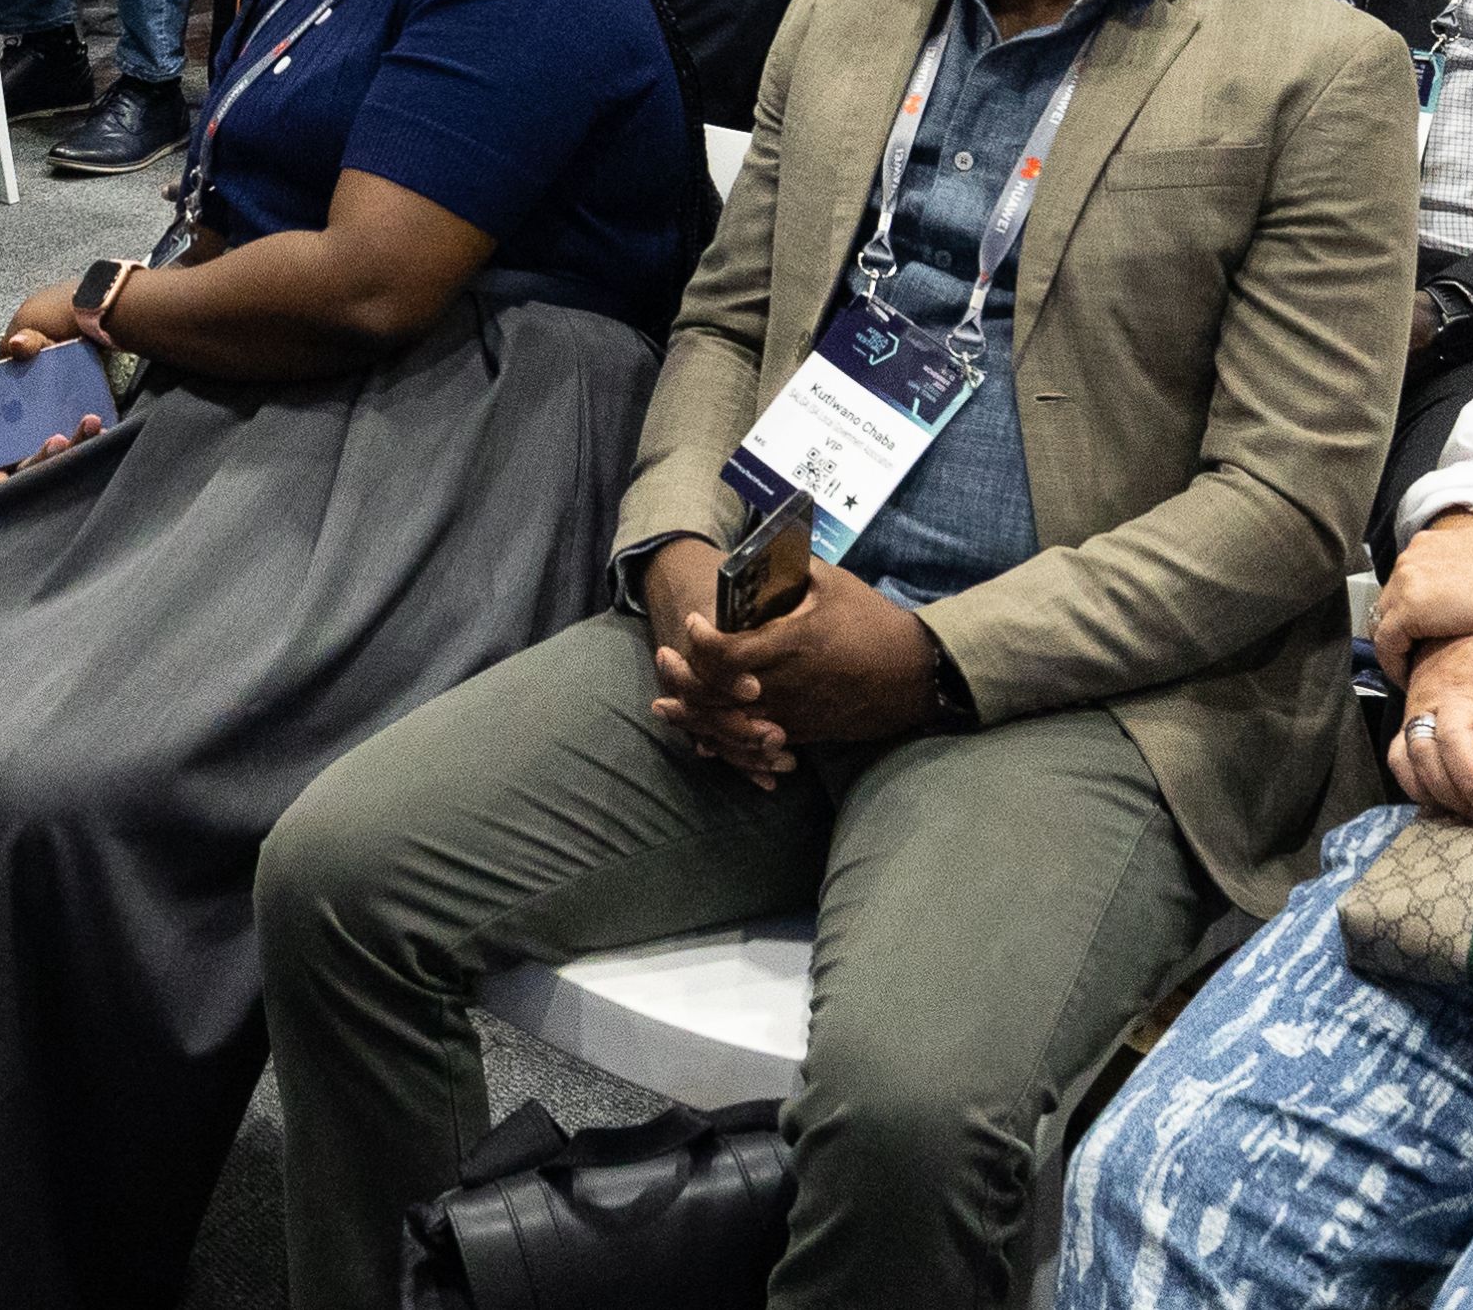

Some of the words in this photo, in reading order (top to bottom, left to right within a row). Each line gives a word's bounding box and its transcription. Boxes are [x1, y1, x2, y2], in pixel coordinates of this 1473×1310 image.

[1049, 74, 1079, 125] UAWEI
[996, 179, 1030, 234] HUAWEI
[808, 382, 863, 426] Kutlwano
[860, 420, 898, 452] Chaba
[823, 436, 843, 454] VIP
